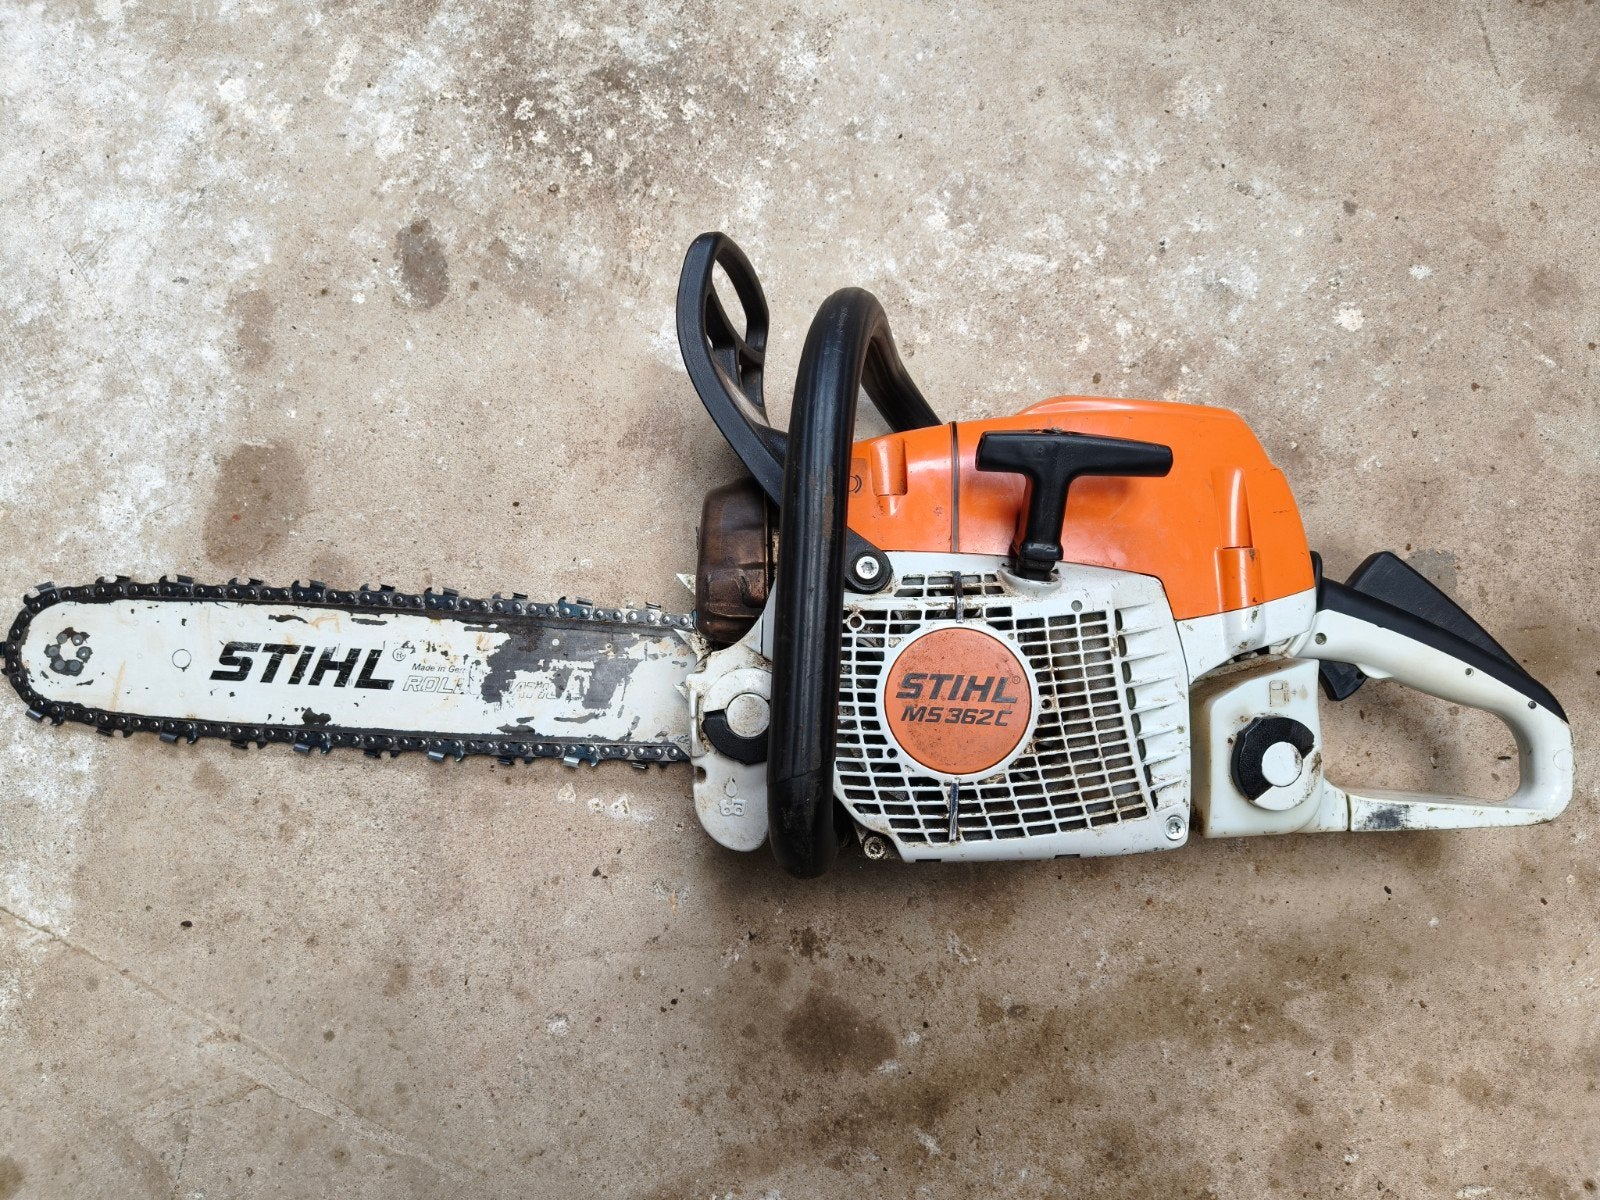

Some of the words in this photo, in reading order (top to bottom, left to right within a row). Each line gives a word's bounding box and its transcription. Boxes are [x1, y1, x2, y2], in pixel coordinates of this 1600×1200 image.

[209, 641, 394, 690] STIHL
[411, 662, 436, 672] Made
[437, 664, 446, 673] in
[896, 672, 1018, 704] STIHL
